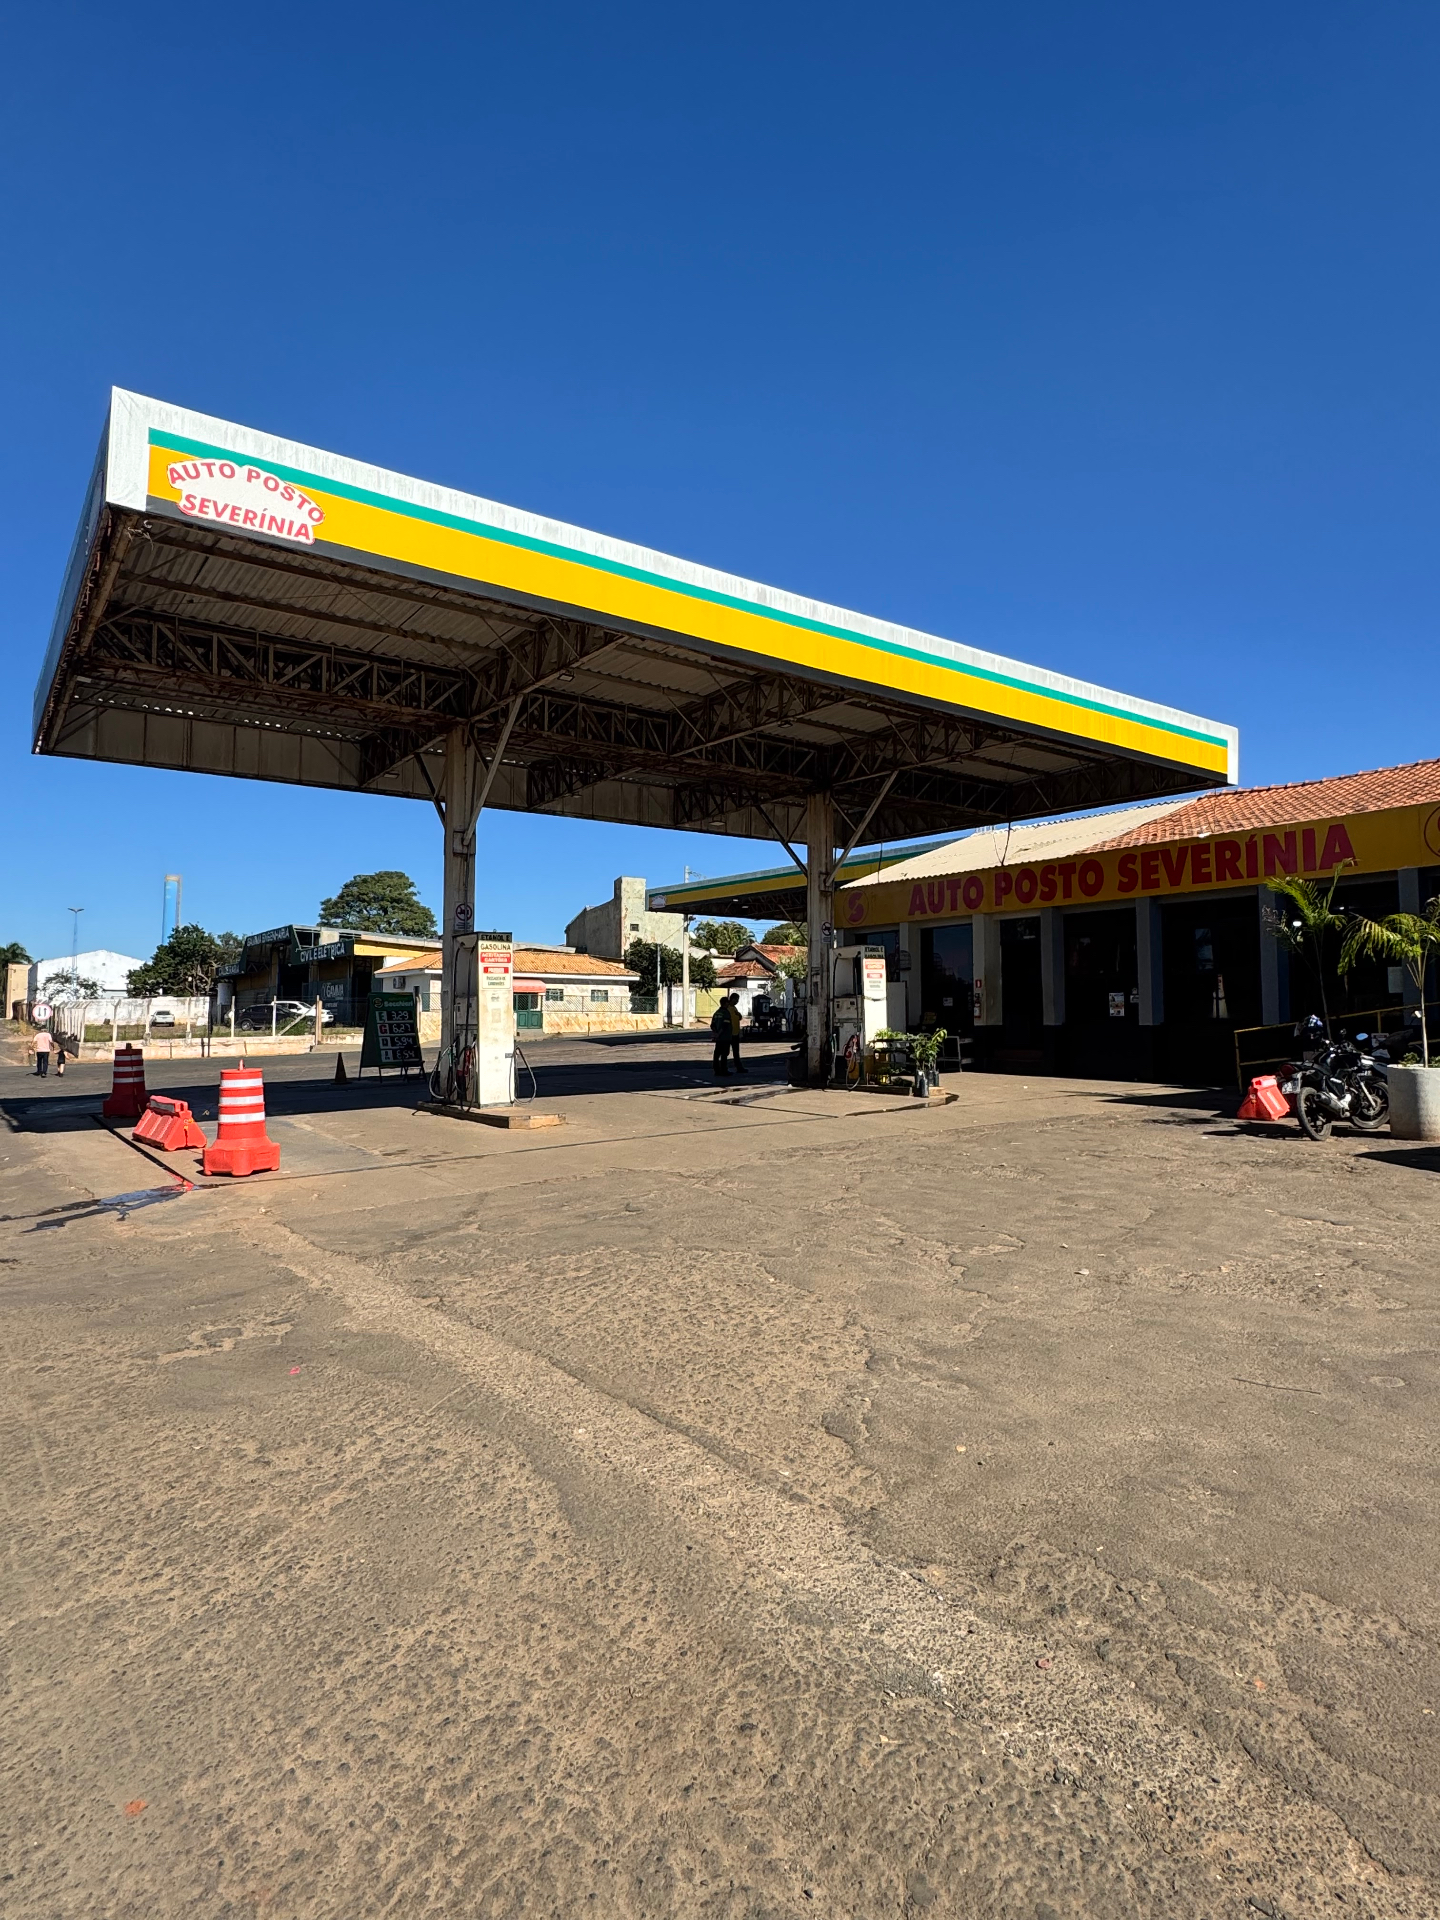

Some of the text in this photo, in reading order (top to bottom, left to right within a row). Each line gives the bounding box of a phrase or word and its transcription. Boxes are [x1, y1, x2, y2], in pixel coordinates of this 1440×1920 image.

[168, 462, 325, 523] AUTO POSTO
[182, 493, 311, 541] SEVERÍNIA
[907, 823, 1358, 916] AUTO POSTO SEVERÍNIA
[480, 943, 511, 951] GASOLINA
